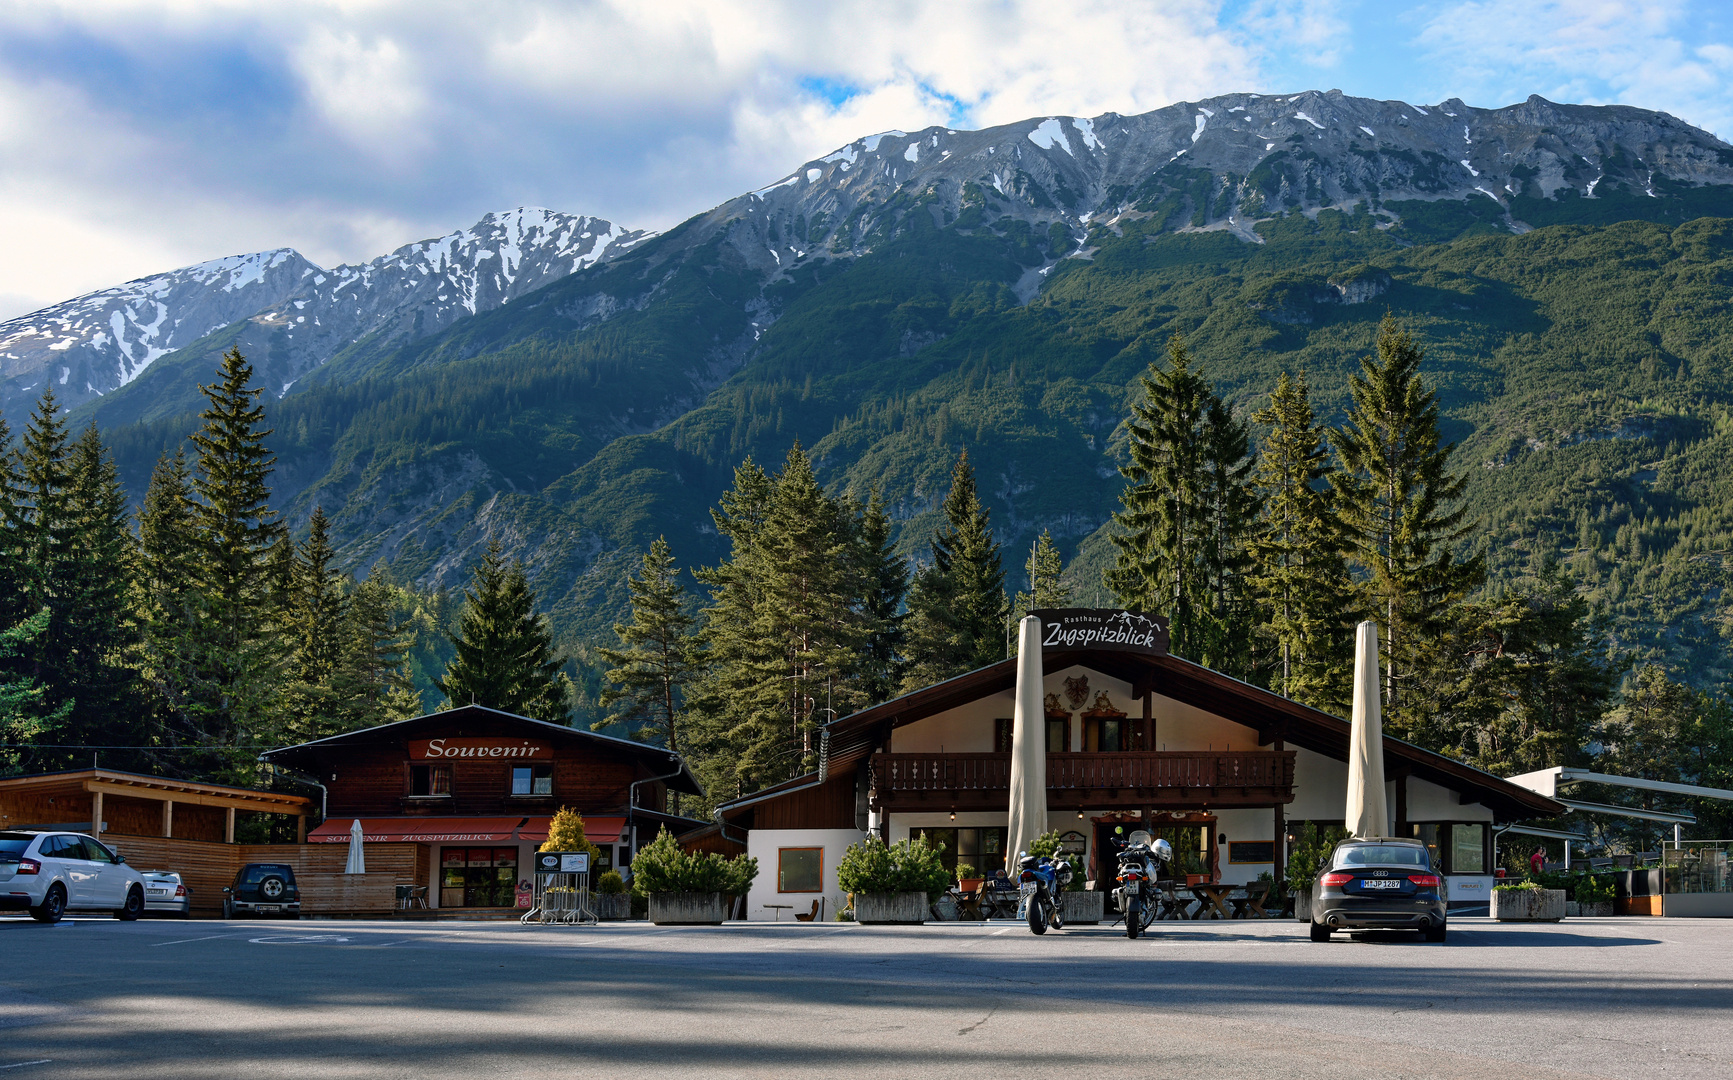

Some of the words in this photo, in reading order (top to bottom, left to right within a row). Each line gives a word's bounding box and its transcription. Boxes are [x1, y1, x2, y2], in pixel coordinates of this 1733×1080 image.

[1064, 615, 1102, 624] Rasthaus
[1043, 622, 1155, 648] Zugspitzblick
[425, 738, 540, 758] Souvenir
[401, 834, 493, 842] ZUGSPITZBLICK
